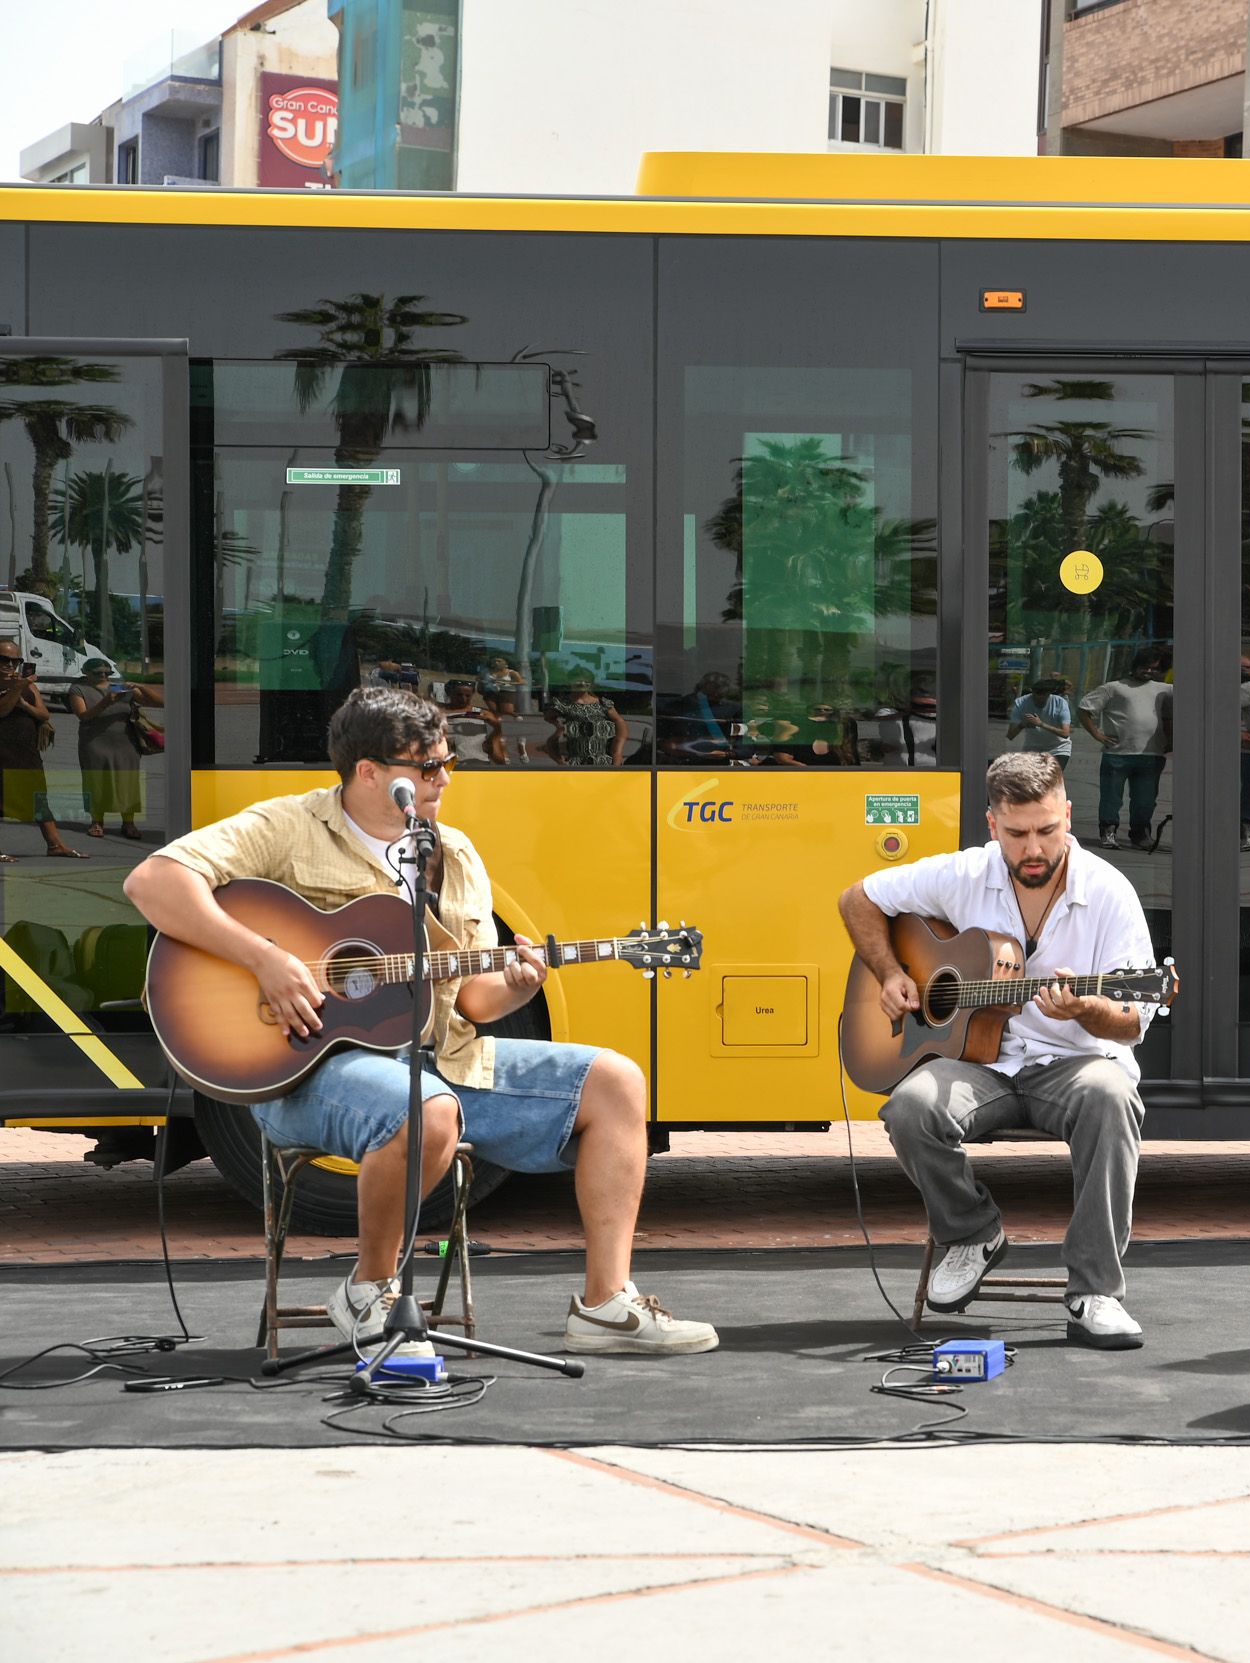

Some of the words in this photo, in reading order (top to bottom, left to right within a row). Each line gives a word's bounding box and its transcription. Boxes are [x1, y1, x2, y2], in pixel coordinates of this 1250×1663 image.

[272, 98, 304, 110] Gran
[683, 802, 734, 822] TGC
[755, 1006, 774, 1014] Urea
